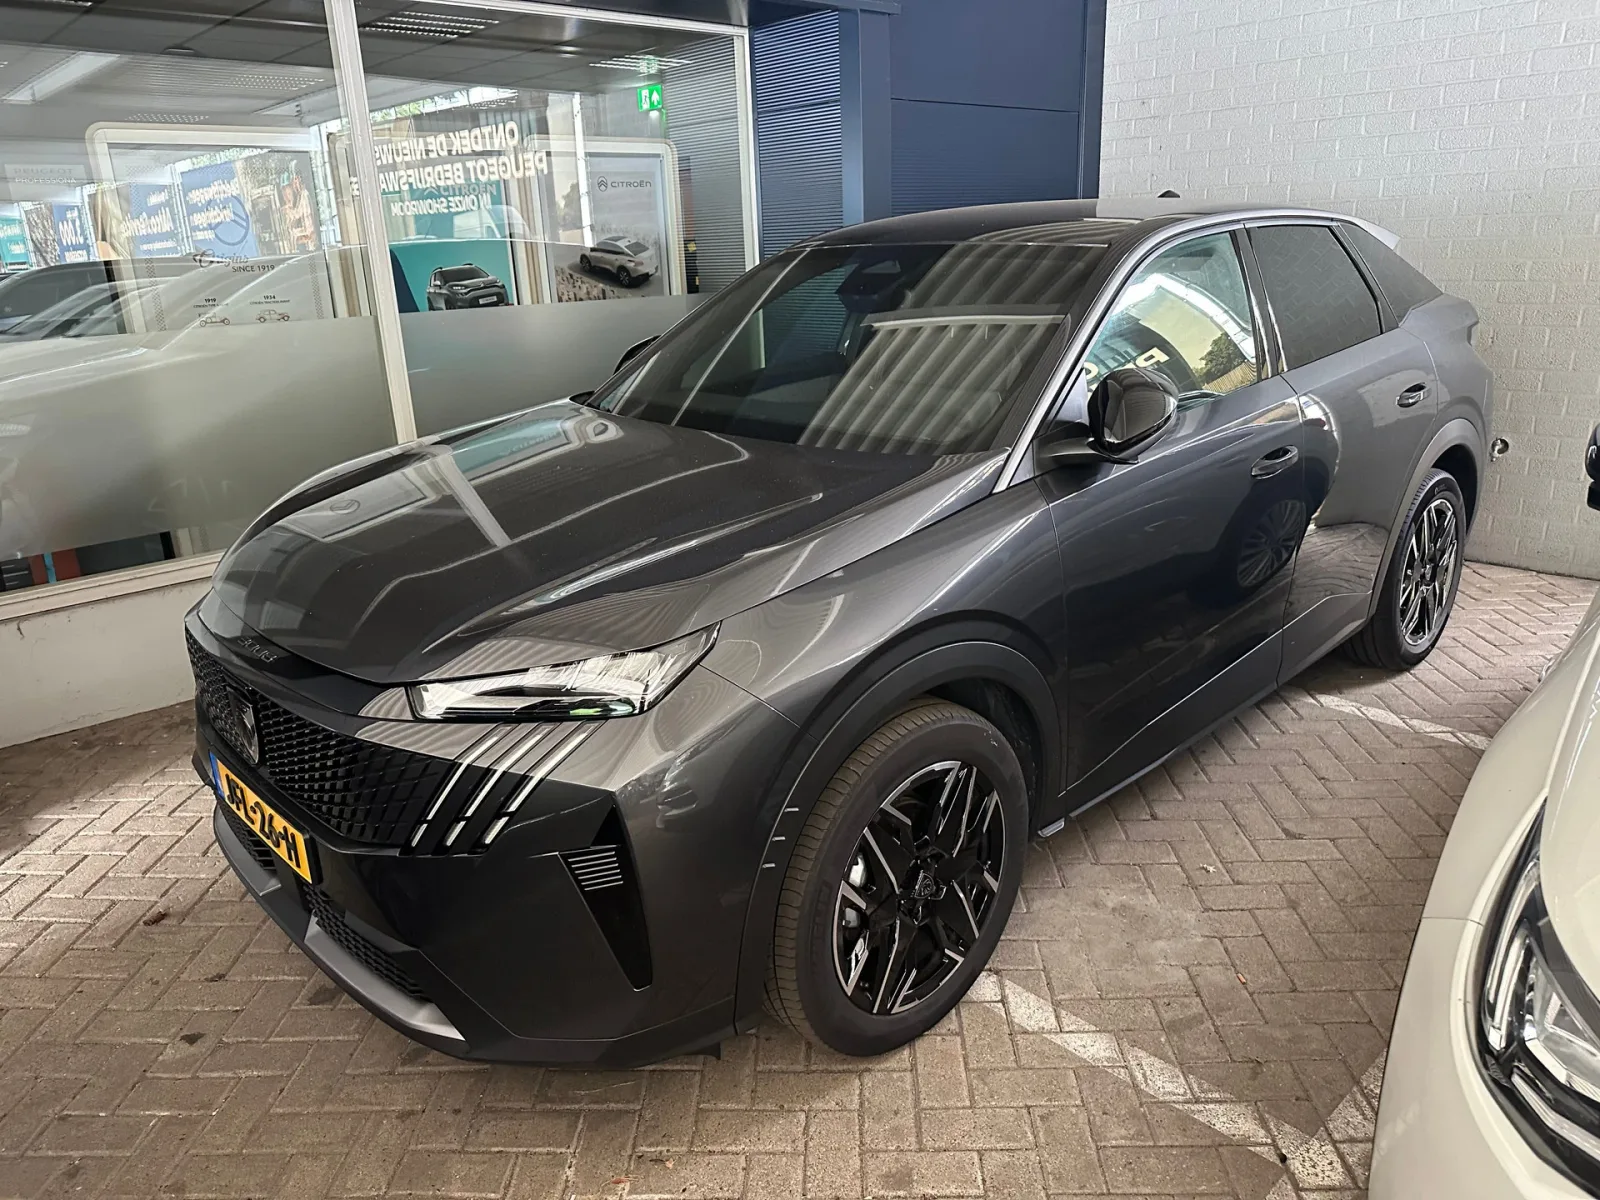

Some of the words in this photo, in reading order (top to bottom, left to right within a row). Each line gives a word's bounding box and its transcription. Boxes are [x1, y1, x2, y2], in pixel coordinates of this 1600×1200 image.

[610, 180, 652, 188] CITROËN
[231, 265, 256, 273] SINCE
[256, 264, 275, 272] 1919
[224, 772, 302, 869] JFL-26-H
